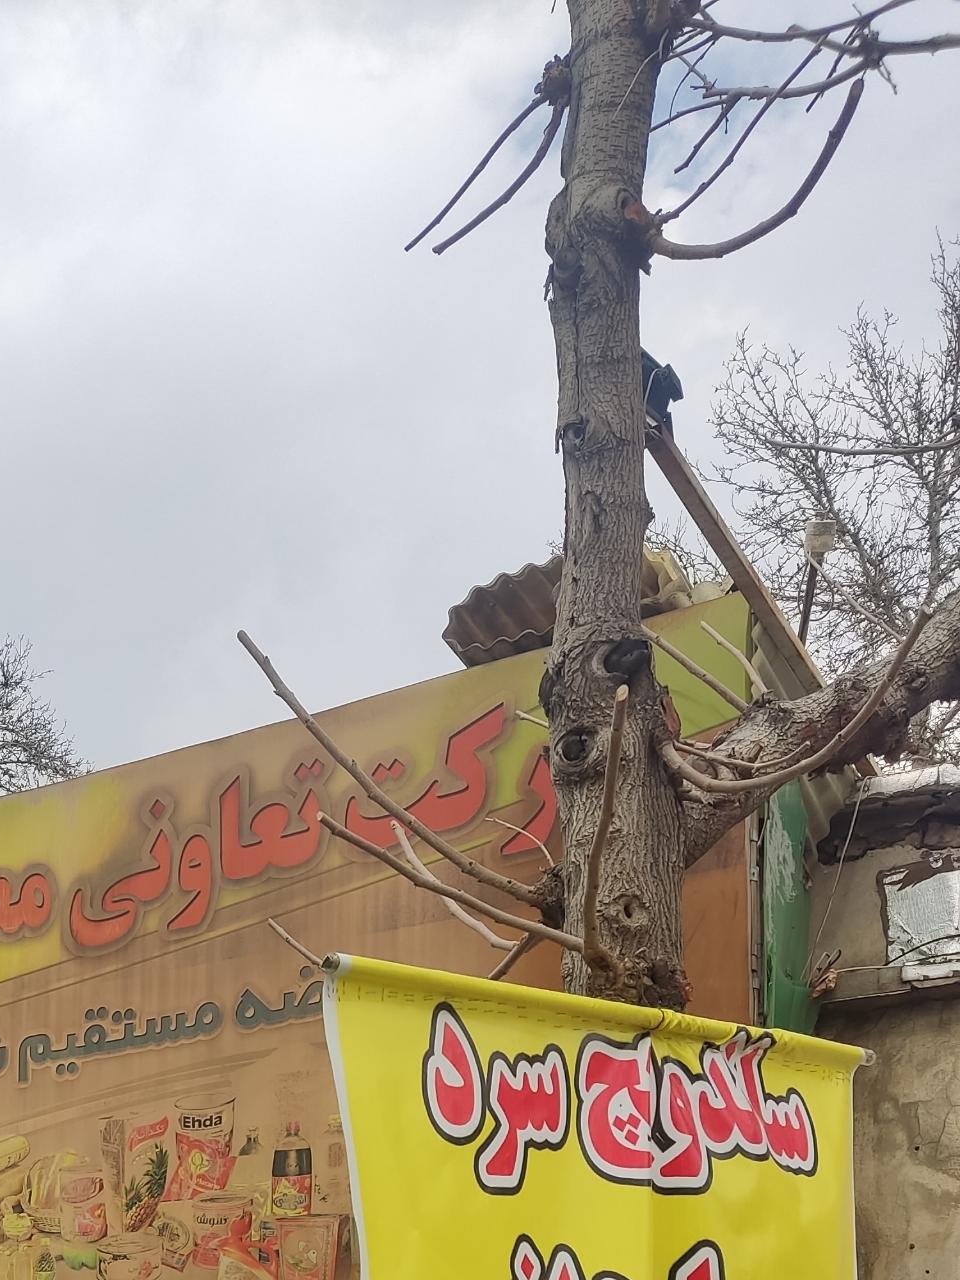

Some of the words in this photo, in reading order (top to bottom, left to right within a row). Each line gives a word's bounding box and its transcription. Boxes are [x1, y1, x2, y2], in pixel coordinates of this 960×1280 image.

[69, 757, 323, 948] تعاونی
[345, 702, 557, 856] رکت
[19, 1000, 221, 1081] مستقیم
[422, 1001, 568, 1195] سرد
[183, 1114, 223, 1130] Ehda
